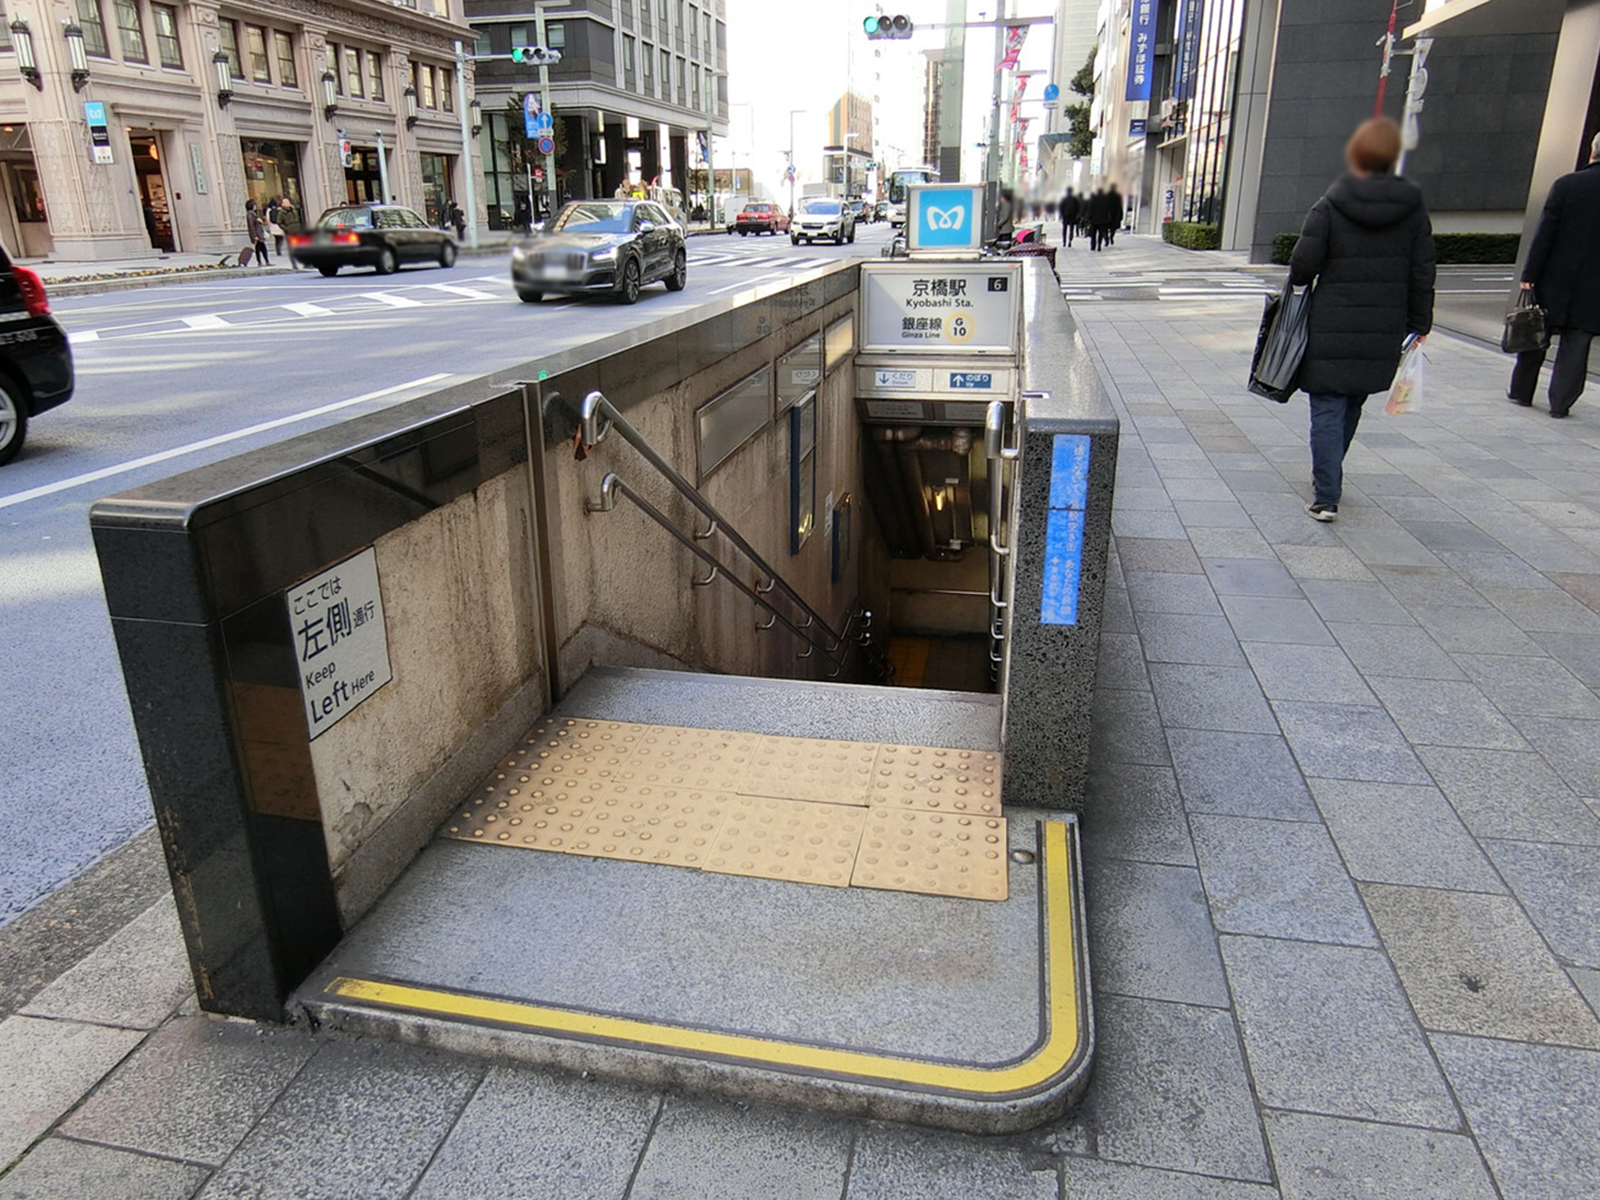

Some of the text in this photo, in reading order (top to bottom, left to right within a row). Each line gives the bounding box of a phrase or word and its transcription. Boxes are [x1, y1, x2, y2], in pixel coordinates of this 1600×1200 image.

[912, 279, 967, 297] 京橋駅
[993, 279, 1002, 290] 6
[906, 299, 974, 309] Kyobashi Sta.
[902, 317, 943, 331] 銀座線
[955, 317, 964, 326] G
[953, 327, 967, 337] 10
[965, 374, 989, 382] のぼり
[294, 576, 342, 615] ここでは
[305, 662, 336, 689] Keep
[311, 670, 375, 723] Left Here
